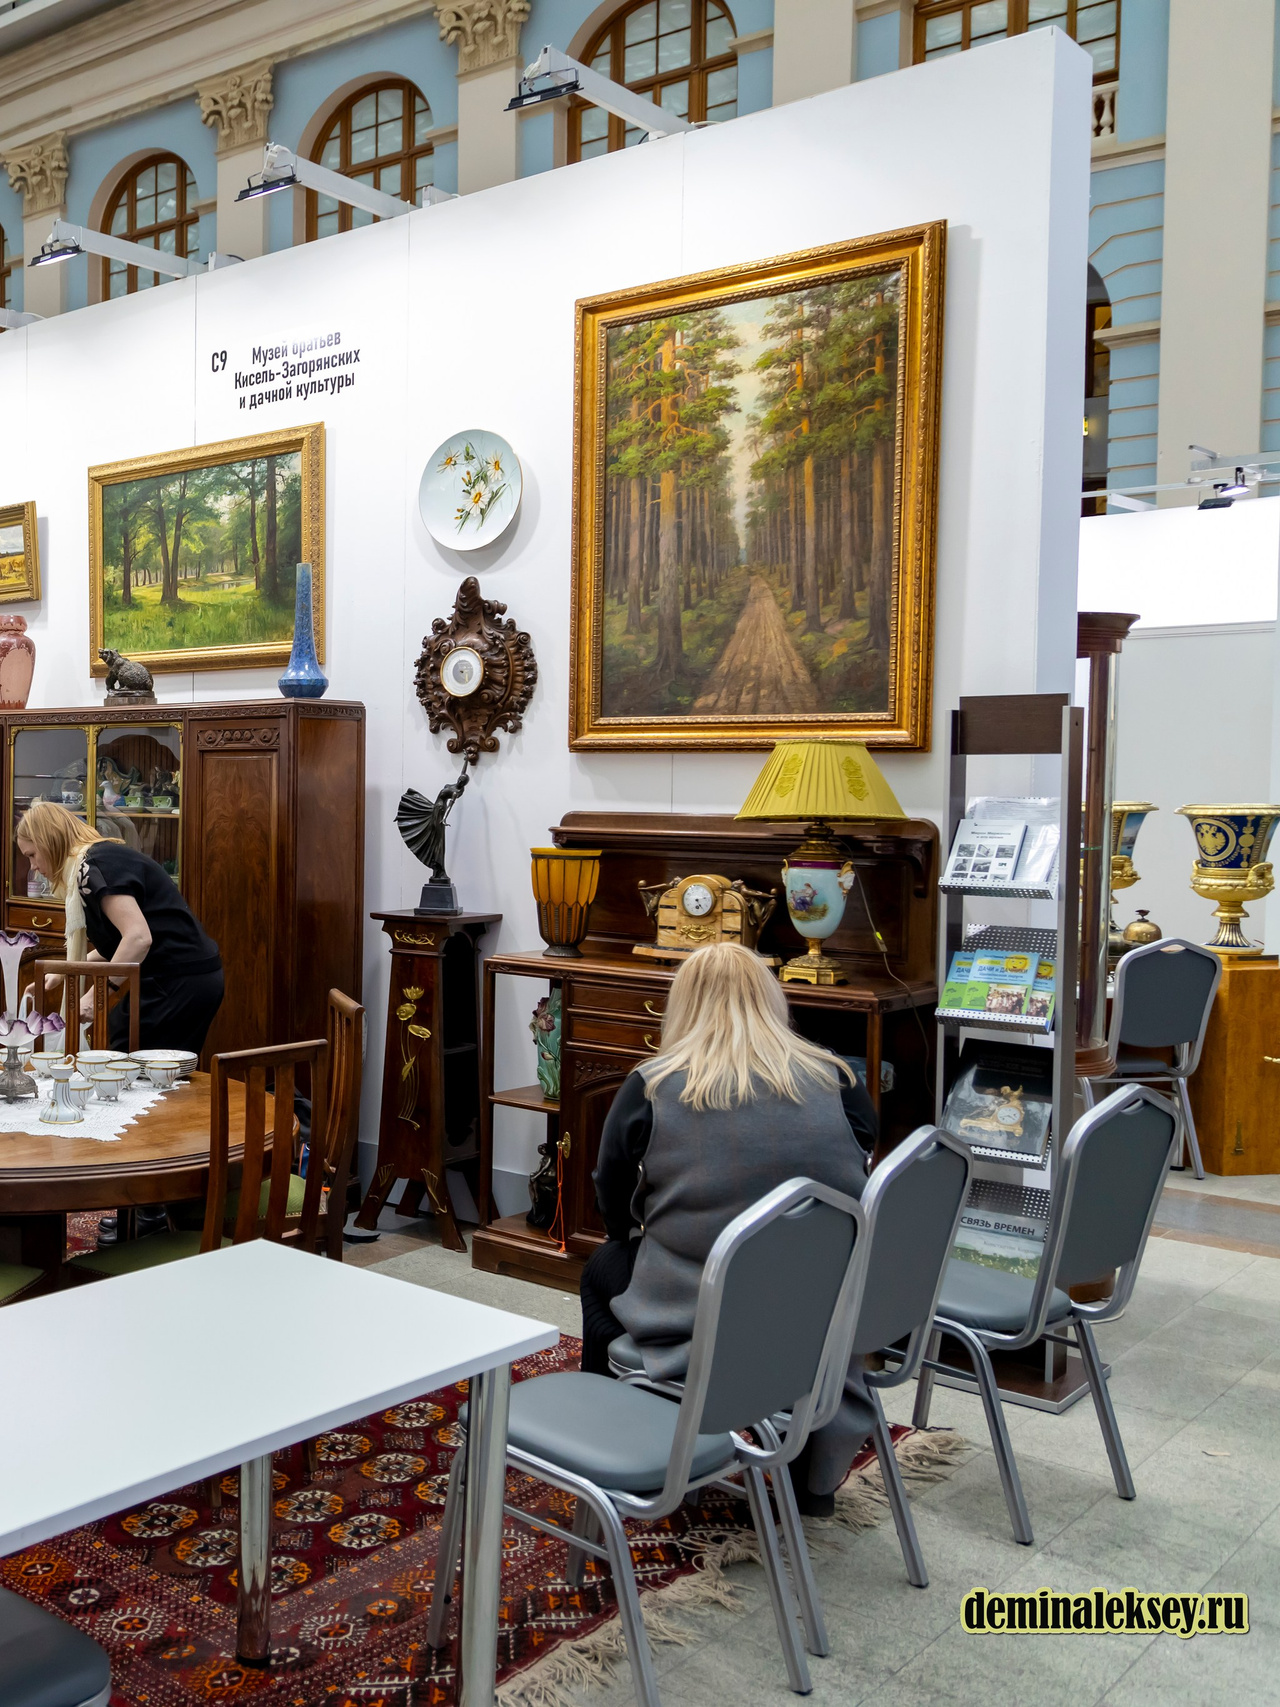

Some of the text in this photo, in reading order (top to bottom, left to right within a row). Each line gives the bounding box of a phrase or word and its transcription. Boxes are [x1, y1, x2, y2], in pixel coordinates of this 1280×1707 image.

[234, 349, 361, 389] Кисель-Загорянских
[252, 339, 288, 367] Музей
[239, 372, 355, 410] и дачной культуры
[960, 1216, 1035, 1236] СВЯЗЬ ВРЕМЕН
